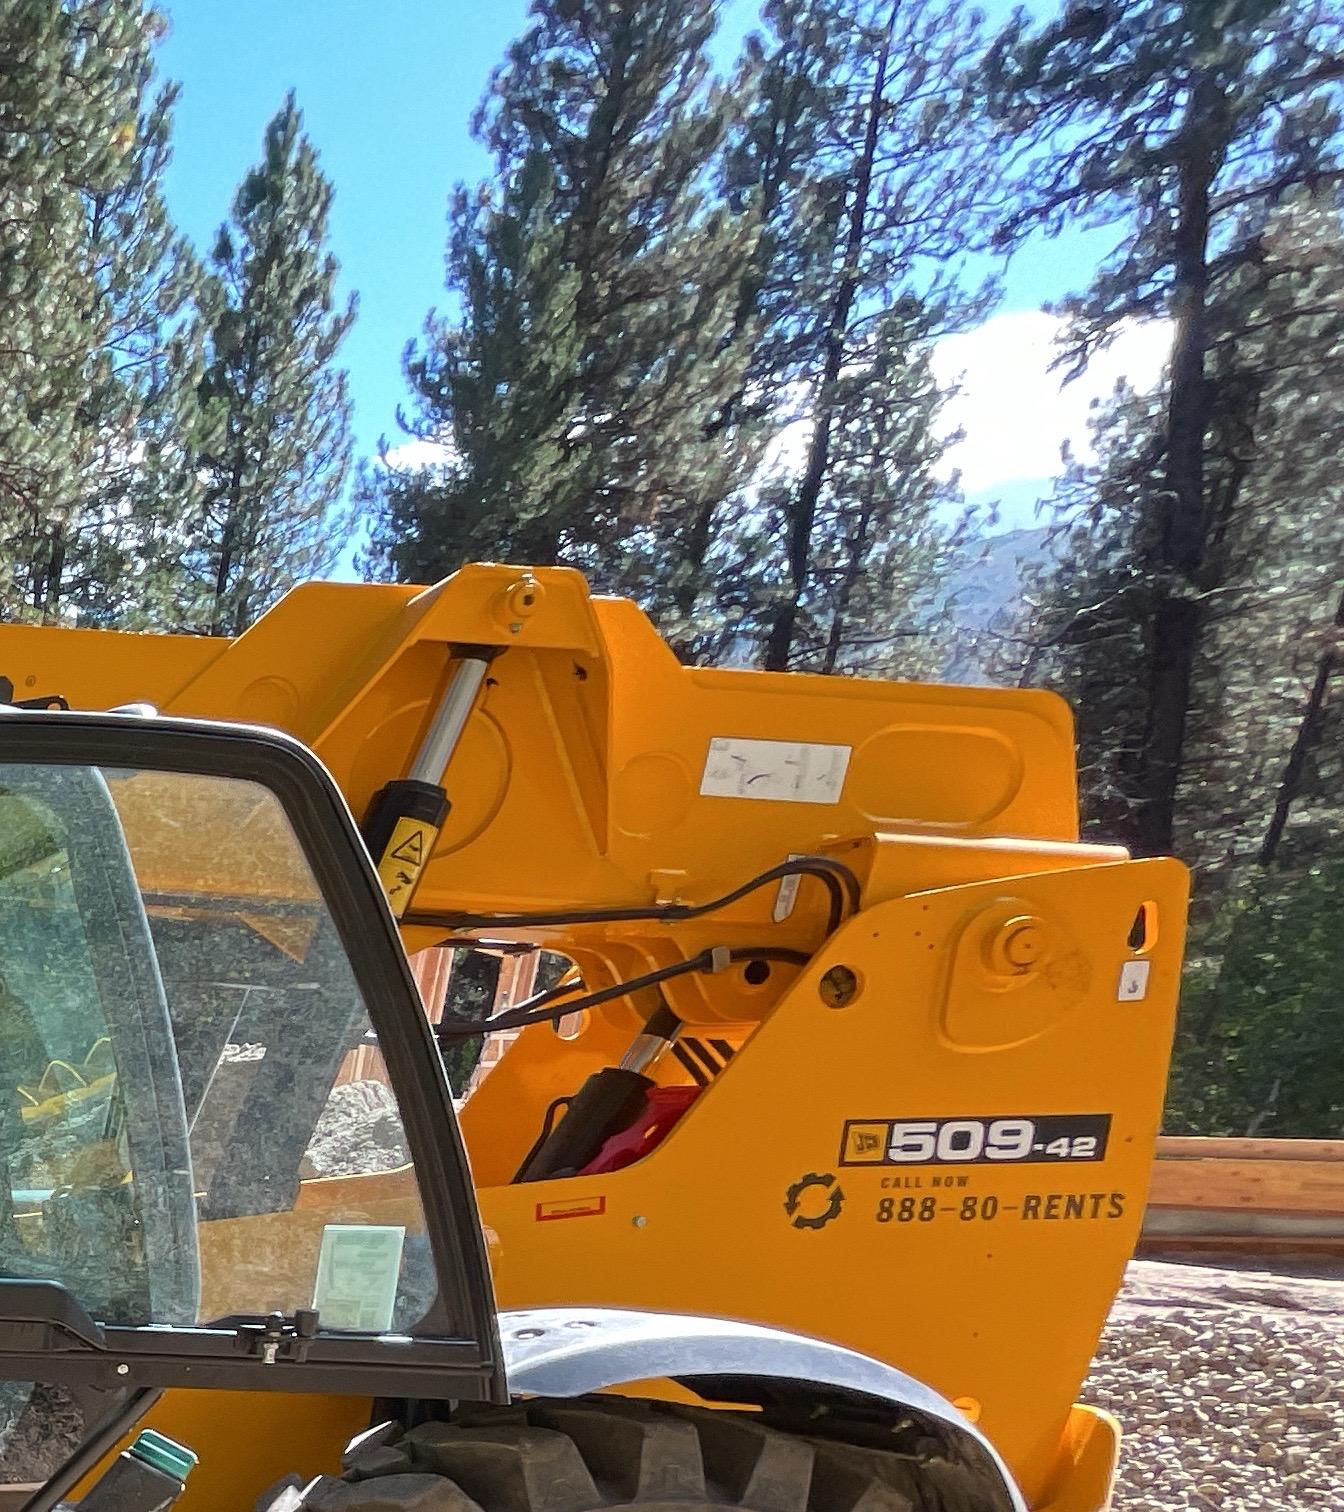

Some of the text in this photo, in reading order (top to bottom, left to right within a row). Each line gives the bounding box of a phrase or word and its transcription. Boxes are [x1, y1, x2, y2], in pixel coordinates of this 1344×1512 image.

[880, 1176, 969, 1189] CALL NOW
[876, 1193, 1126, 1223] 888-80-RENTS
